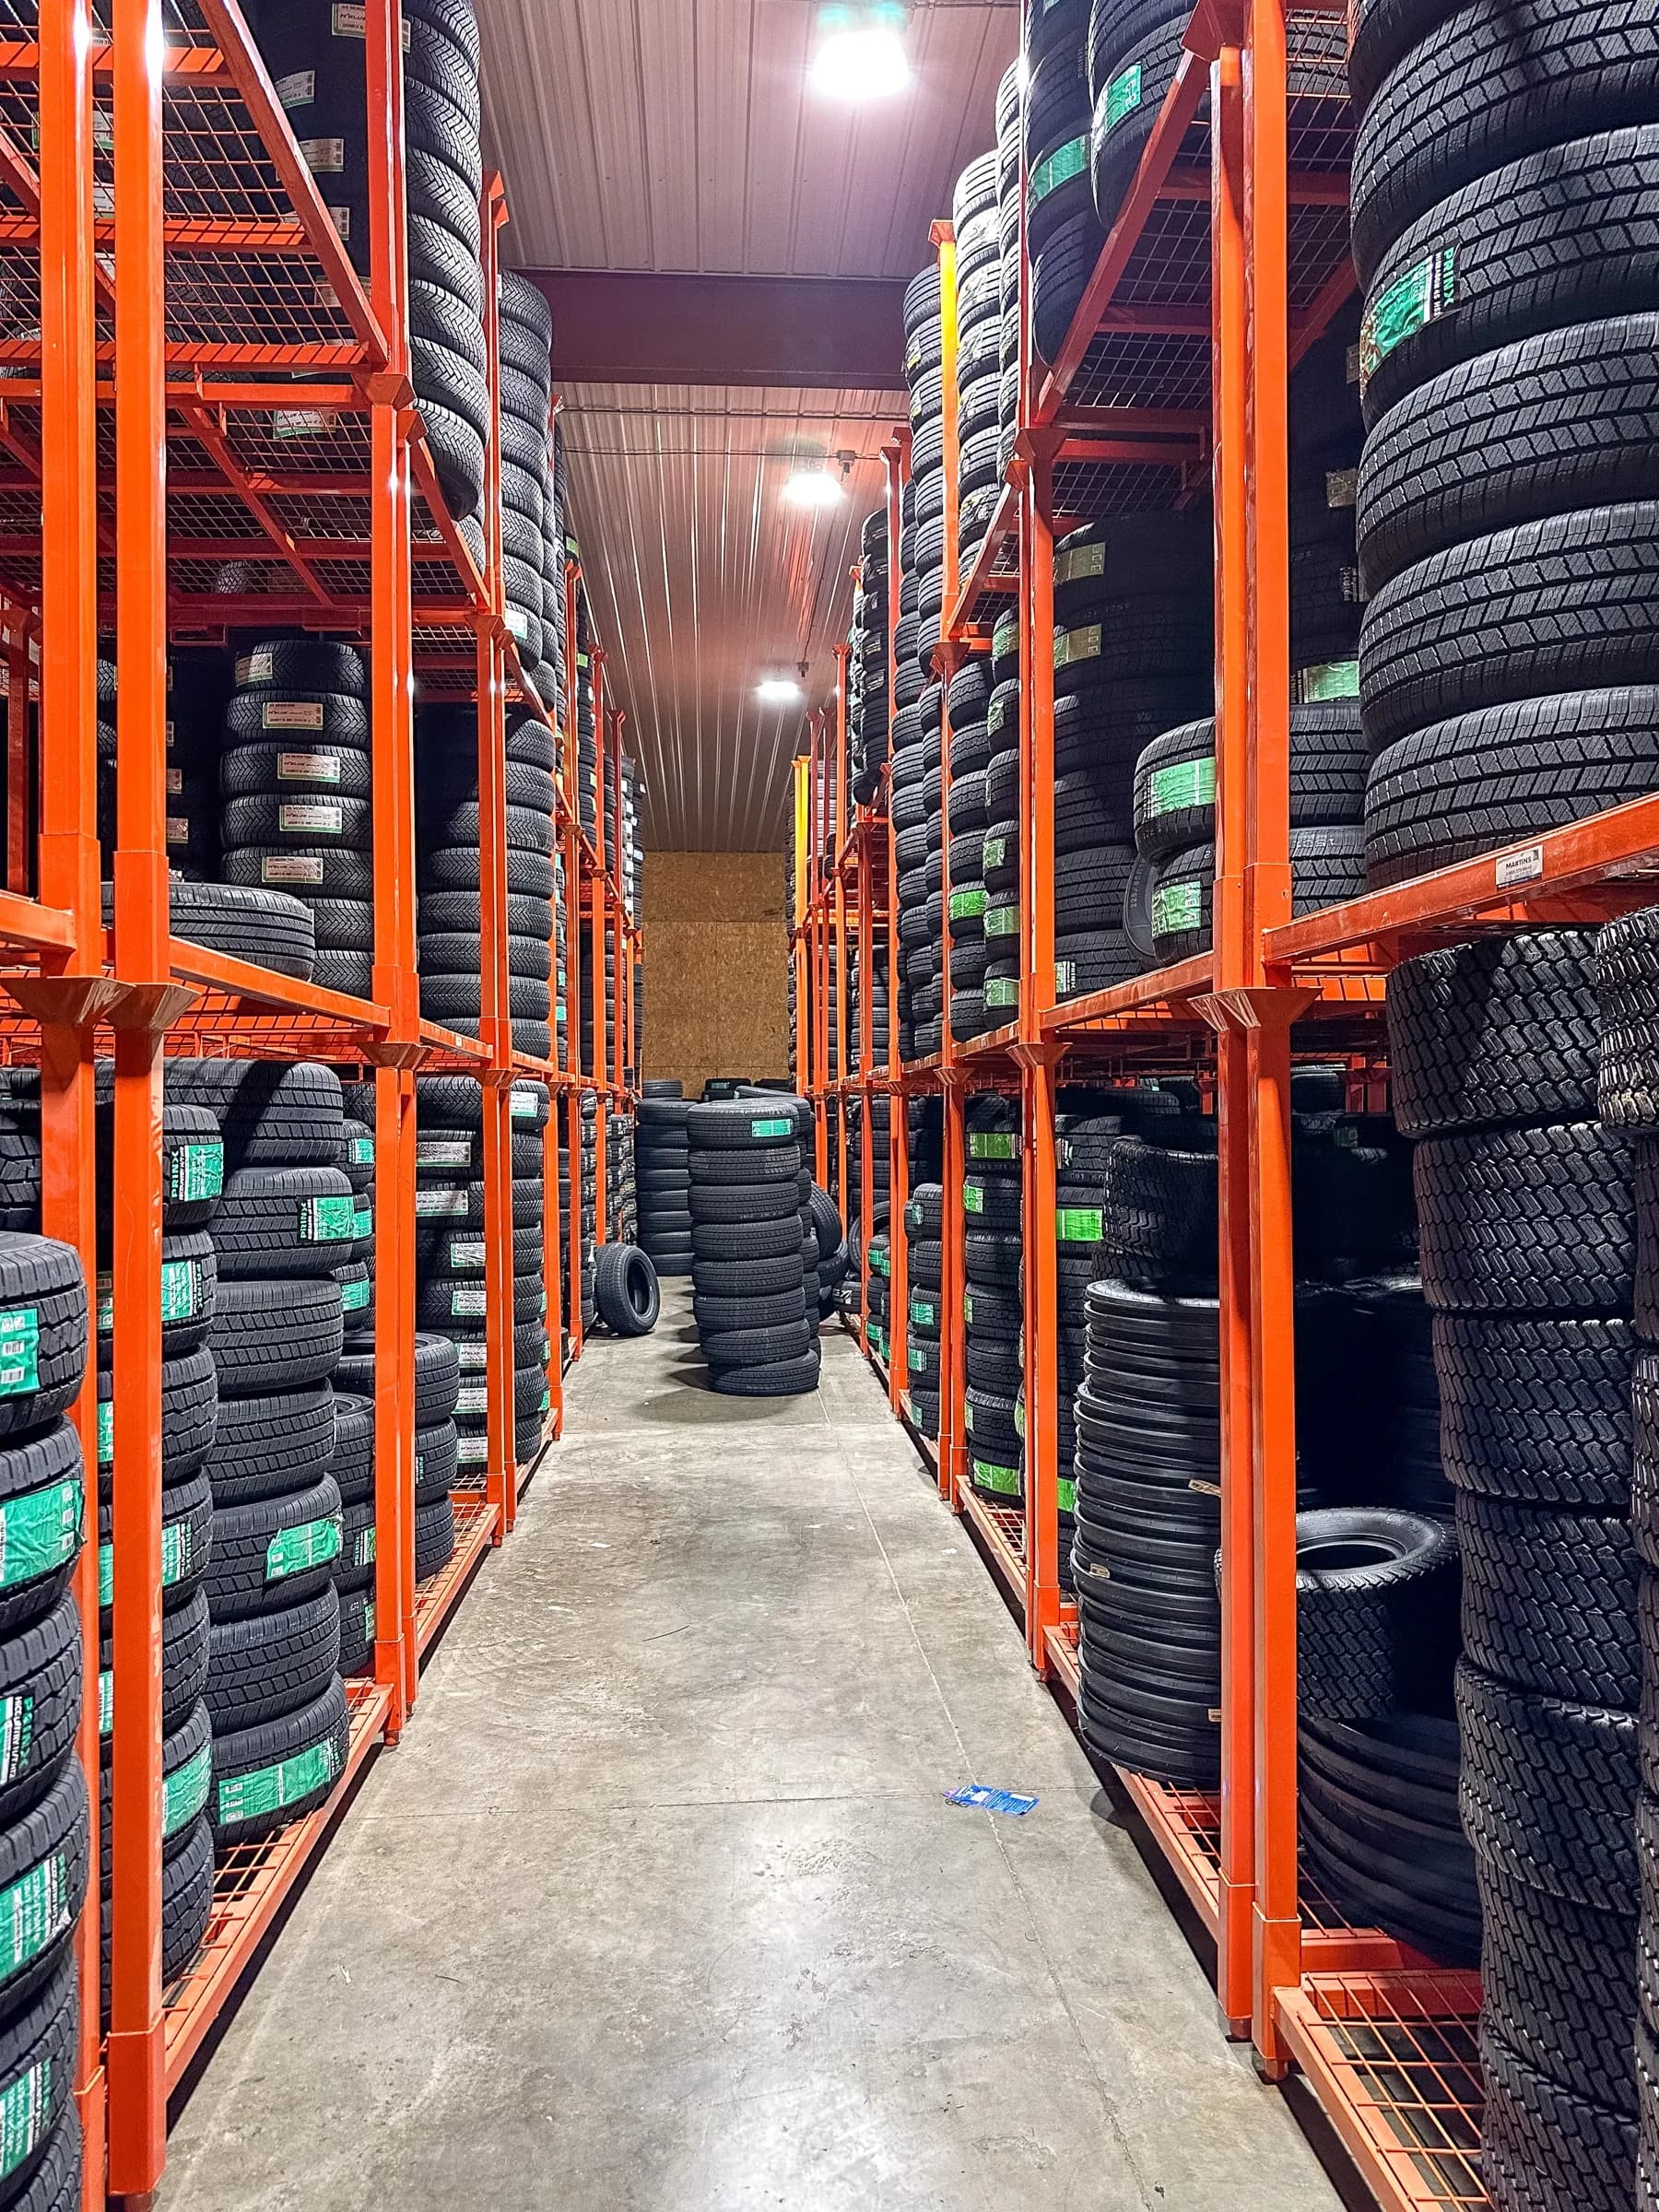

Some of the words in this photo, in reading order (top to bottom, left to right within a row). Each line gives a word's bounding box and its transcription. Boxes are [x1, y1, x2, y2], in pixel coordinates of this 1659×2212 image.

[1443, 247, 1454, 308] PRINX
[1505, 856, 1532, 870] MARTINS
[13, 1696, 23, 1746] HICOUNTRY
[19, 1696, 33, 1769] PRINX
